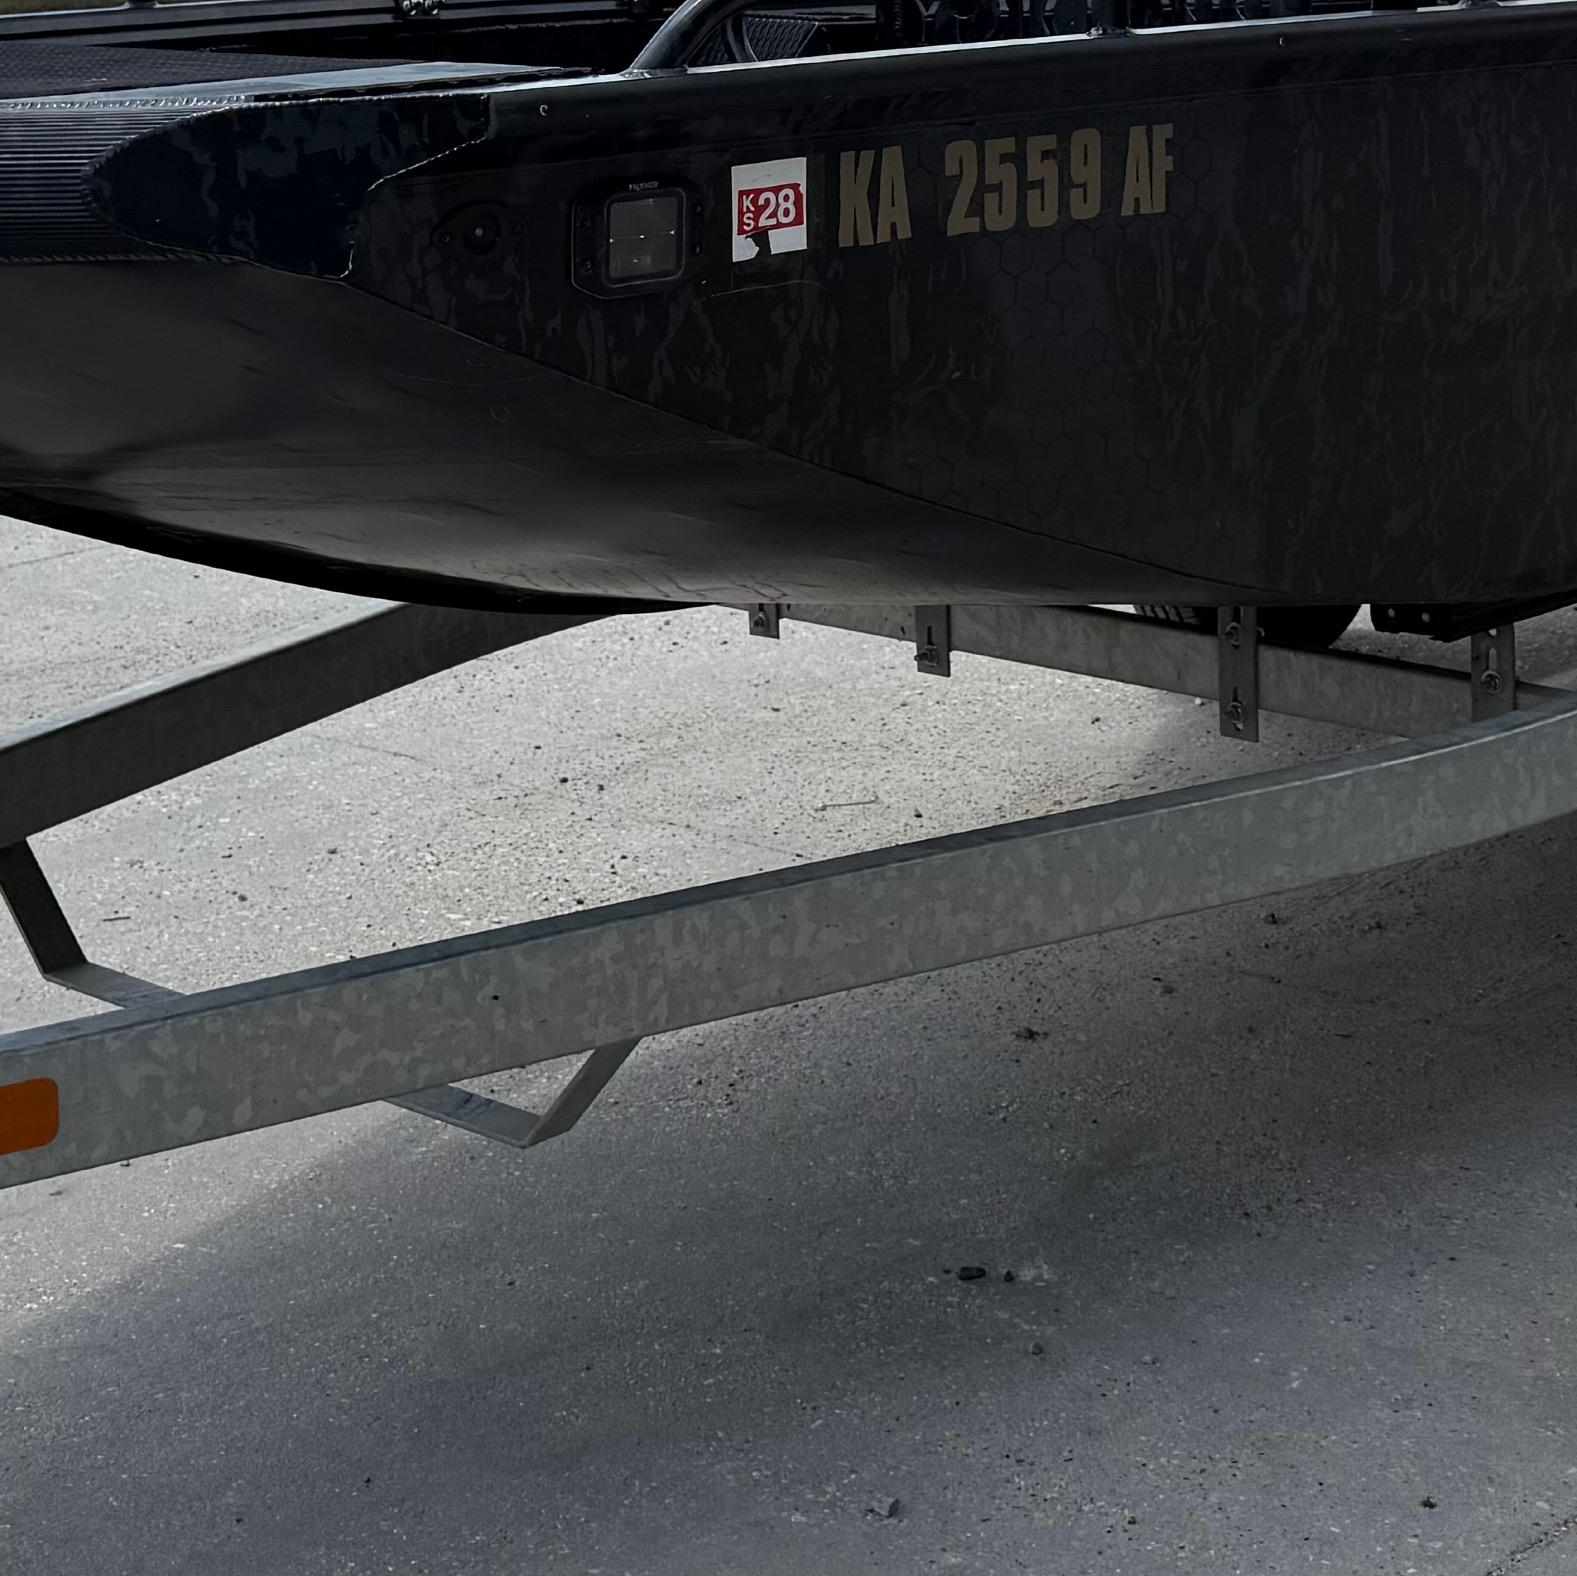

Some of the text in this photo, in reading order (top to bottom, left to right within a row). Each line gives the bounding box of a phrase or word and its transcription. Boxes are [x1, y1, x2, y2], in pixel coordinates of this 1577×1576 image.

[757, 187, 796, 227] 28
[839, 124, 1175, 248] KA 2559 AF
